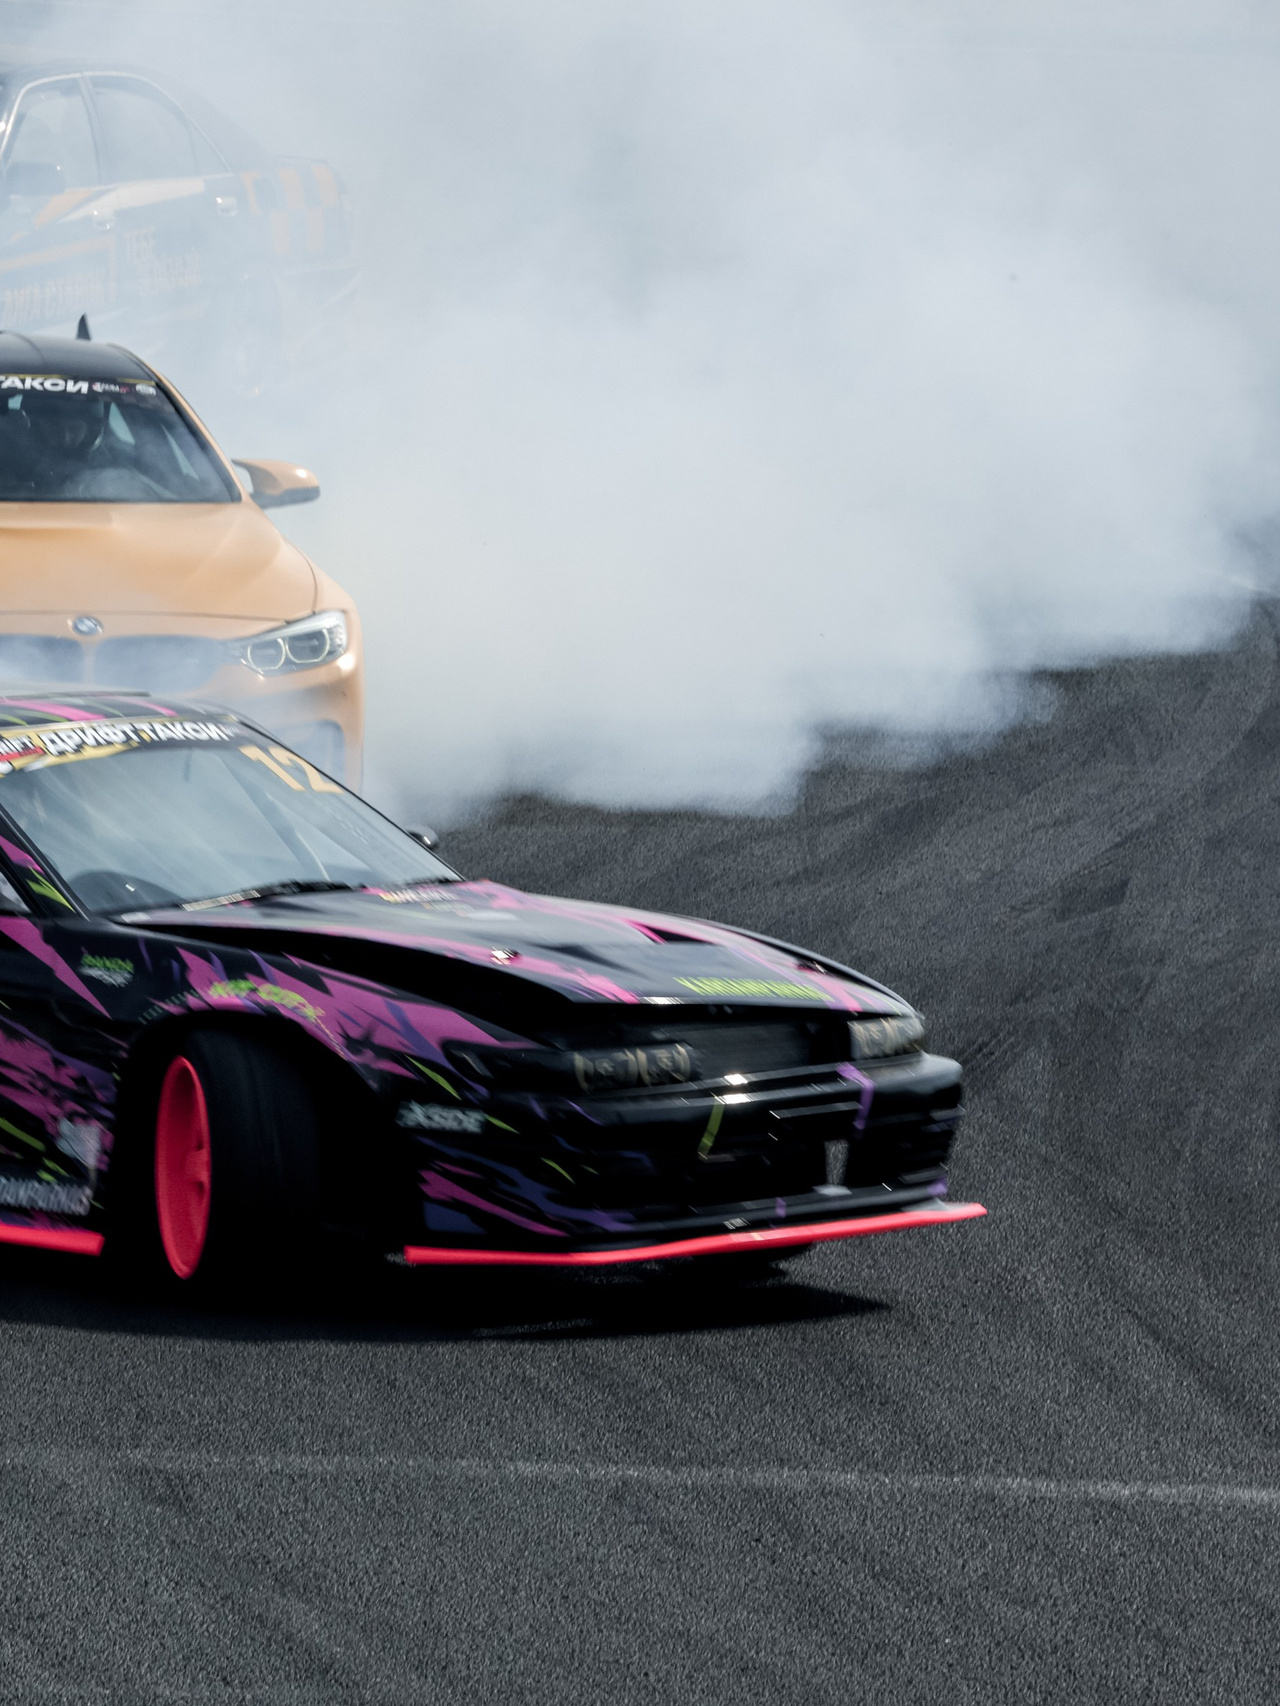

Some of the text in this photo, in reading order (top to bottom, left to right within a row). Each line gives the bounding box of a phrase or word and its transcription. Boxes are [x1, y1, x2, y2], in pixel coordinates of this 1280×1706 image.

[39, 722, 140, 756] ДРИФТ
[142, 719, 230, 742] ТАКСИ
[237, 745, 344, 794] 12
